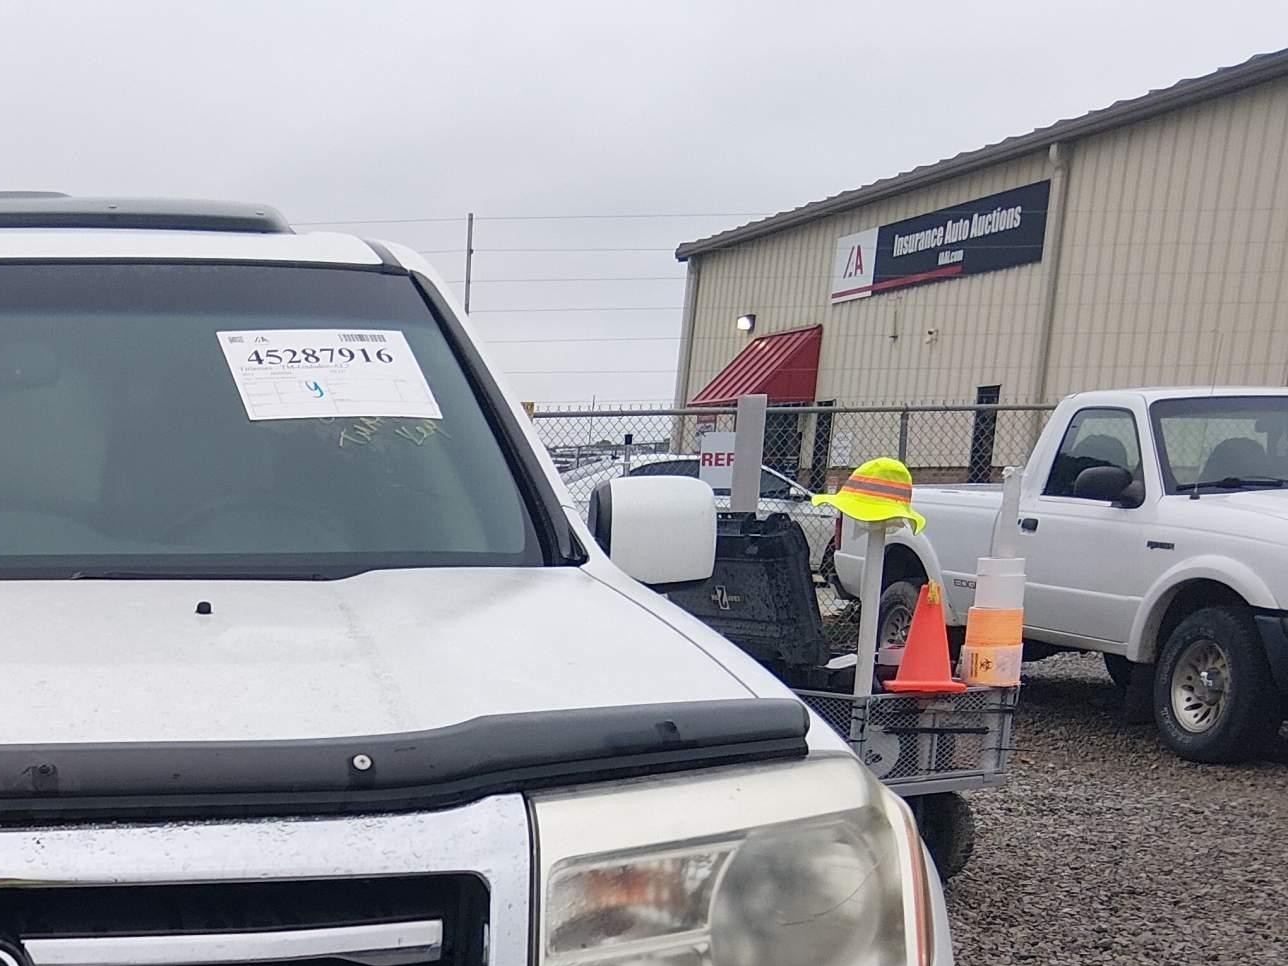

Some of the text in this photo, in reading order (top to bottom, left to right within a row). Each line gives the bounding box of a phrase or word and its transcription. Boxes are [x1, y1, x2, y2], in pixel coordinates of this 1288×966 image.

[893, 206, 1022, 257] Insurance Auto Auctions
[247, 347, 394, 365] 45287916
